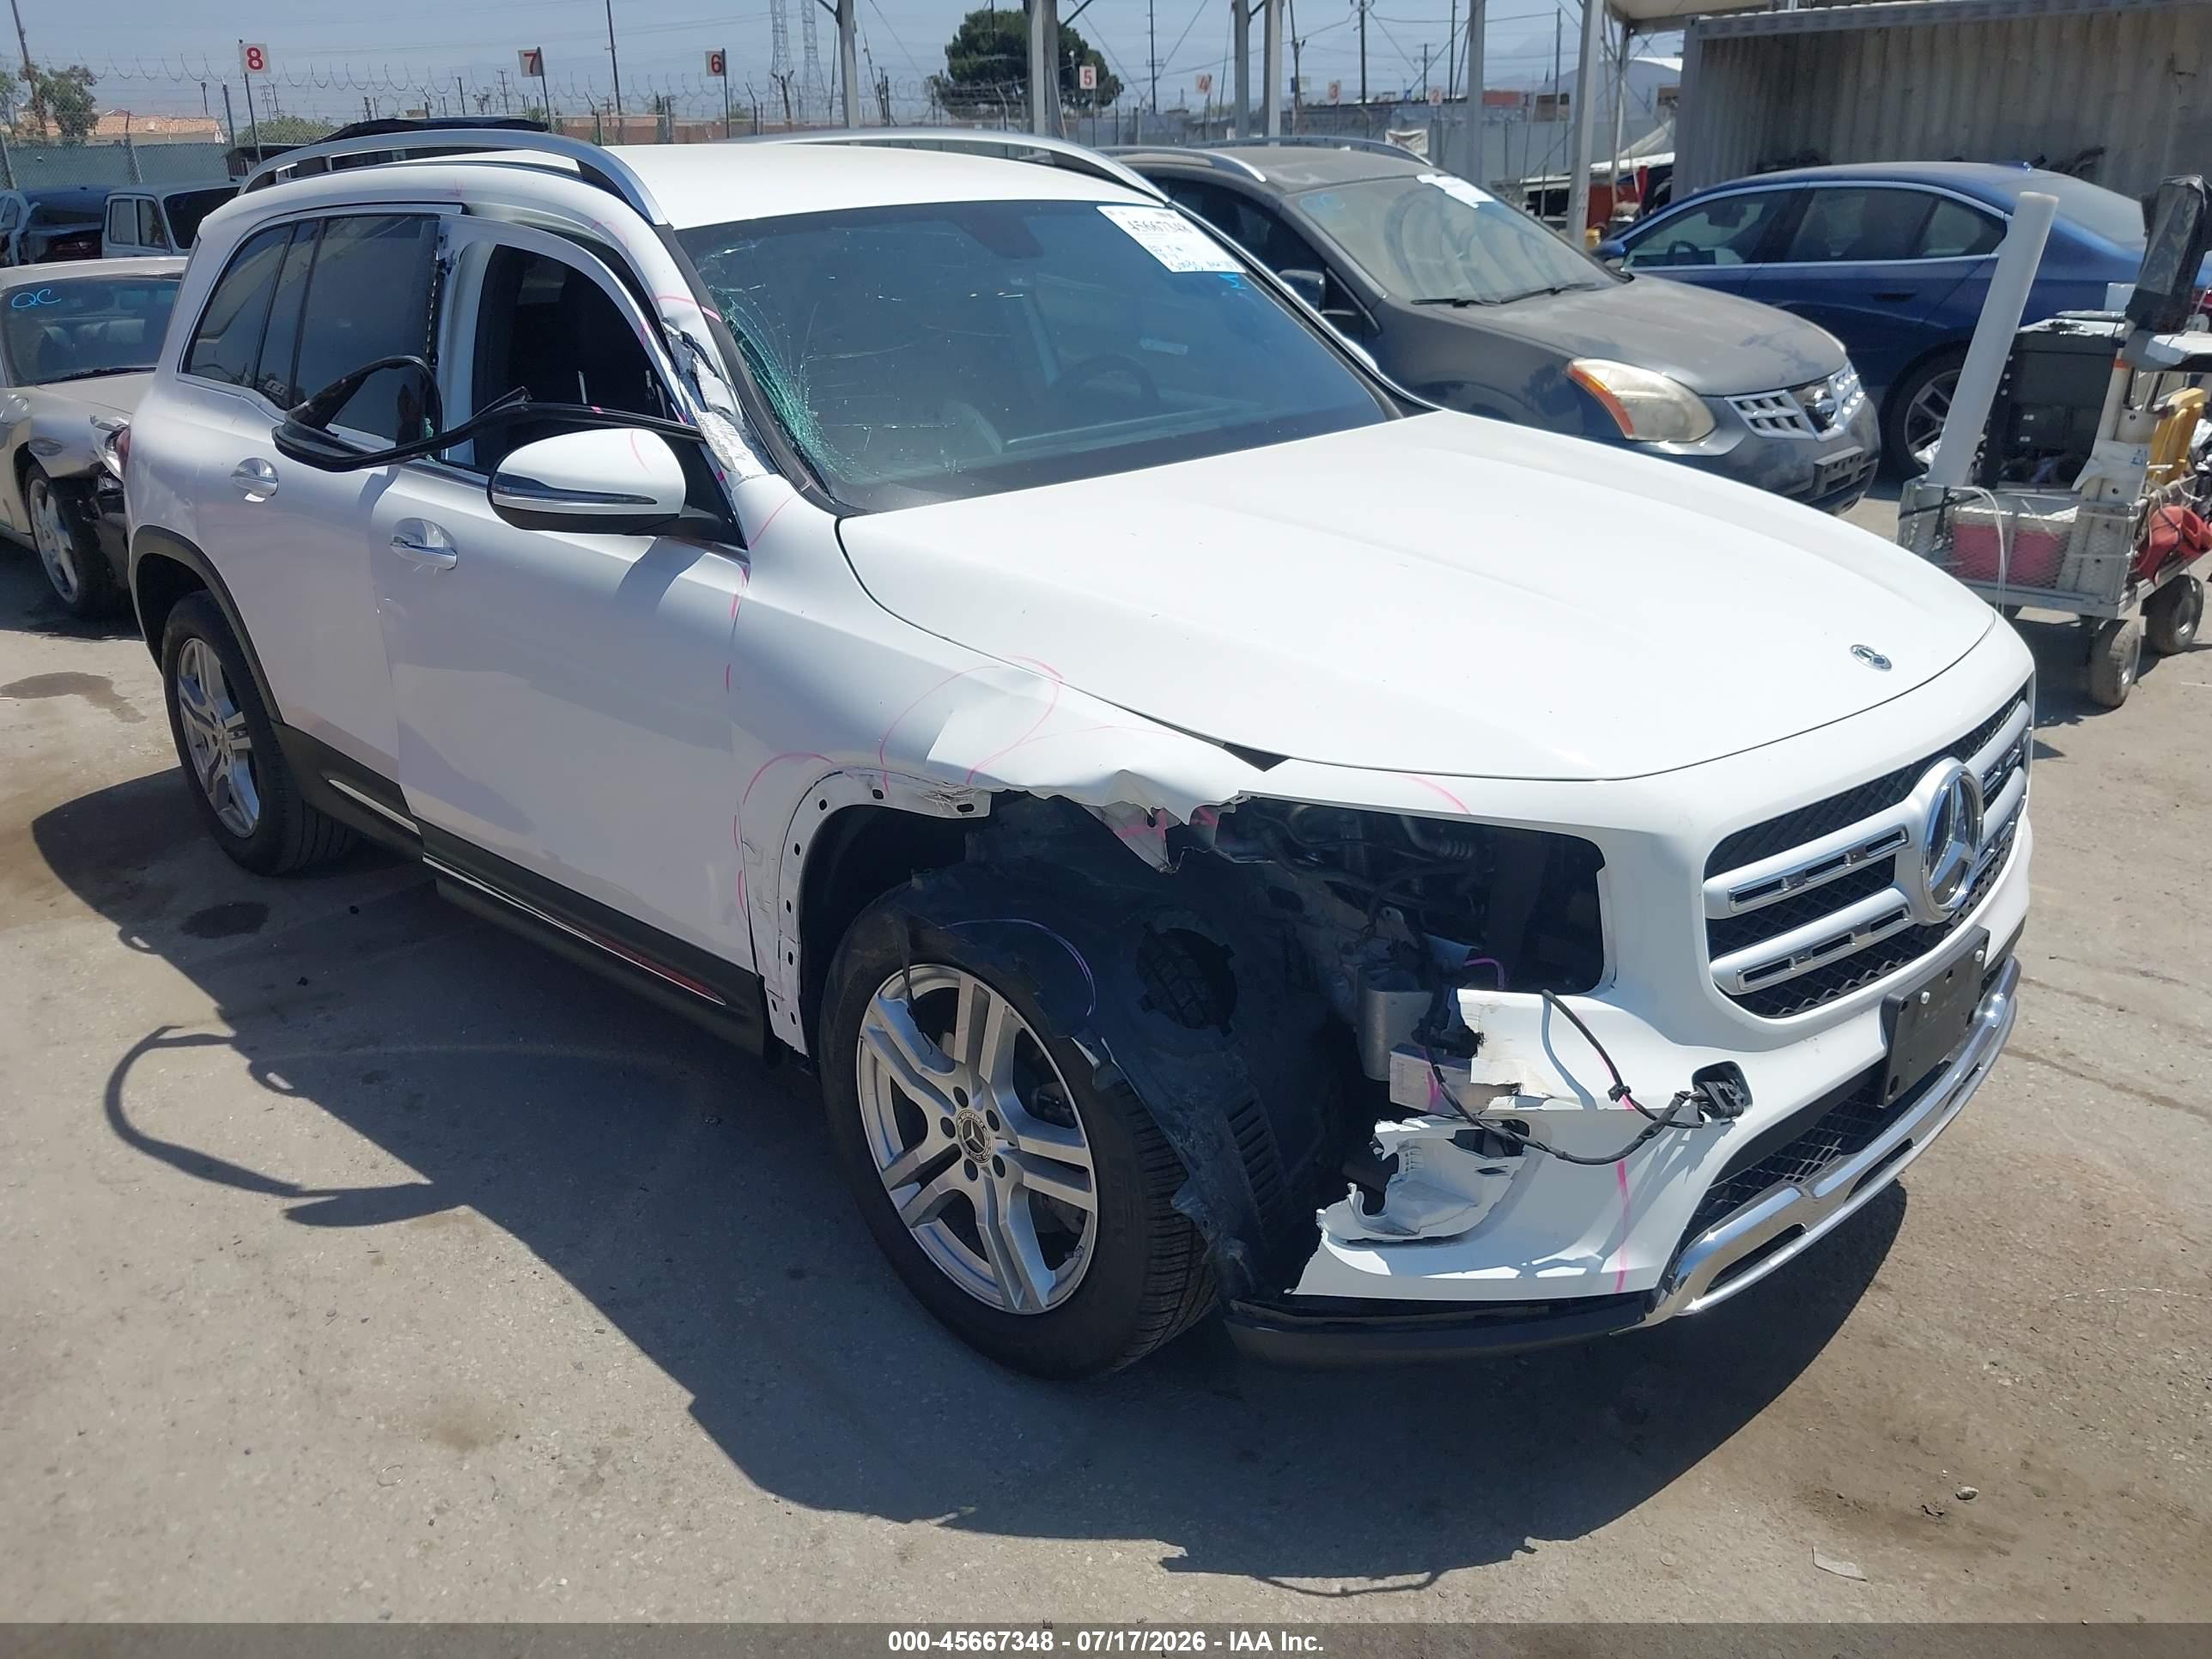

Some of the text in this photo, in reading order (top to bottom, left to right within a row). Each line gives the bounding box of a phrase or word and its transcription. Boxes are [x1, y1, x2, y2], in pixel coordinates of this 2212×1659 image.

[246, 46, 264, 70] 8
[523, 52, 537, 74] 7
[711, 53, 723, 74] 6
[1084, 69, 1093, 87] 5
[1199, 75, 1209, 93] 4
[1330, 83, 1339, 100] 3
[1431, 88, 1440, 103] 2
[11, 288, 63, 308] QC
